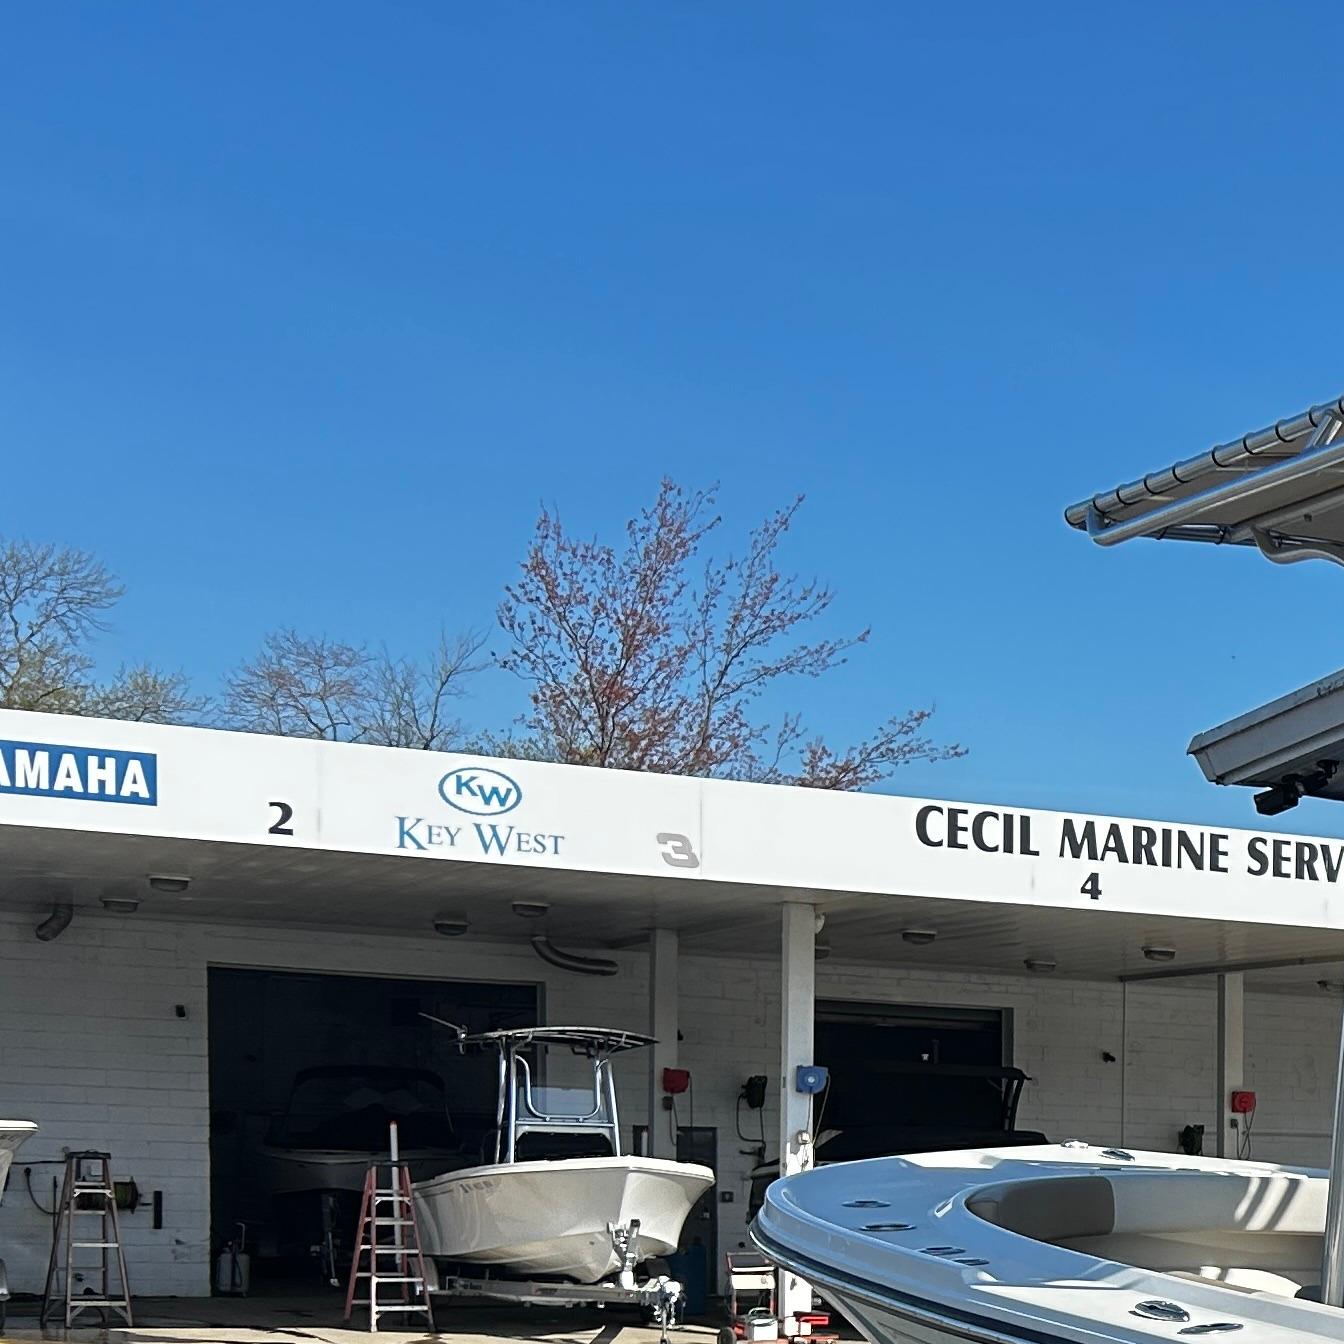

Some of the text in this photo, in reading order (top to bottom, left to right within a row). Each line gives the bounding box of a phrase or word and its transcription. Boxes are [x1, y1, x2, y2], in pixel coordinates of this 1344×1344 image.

[455, 774, 513, 807] KW
[267, 801, 294, 836] 2
[656, 832, 700, 869] 3
[915, 804, 1040, 857] CECIL
[1059, 818, 1229, 873] MARINE
[1080, 872, 1102, 900] 4
